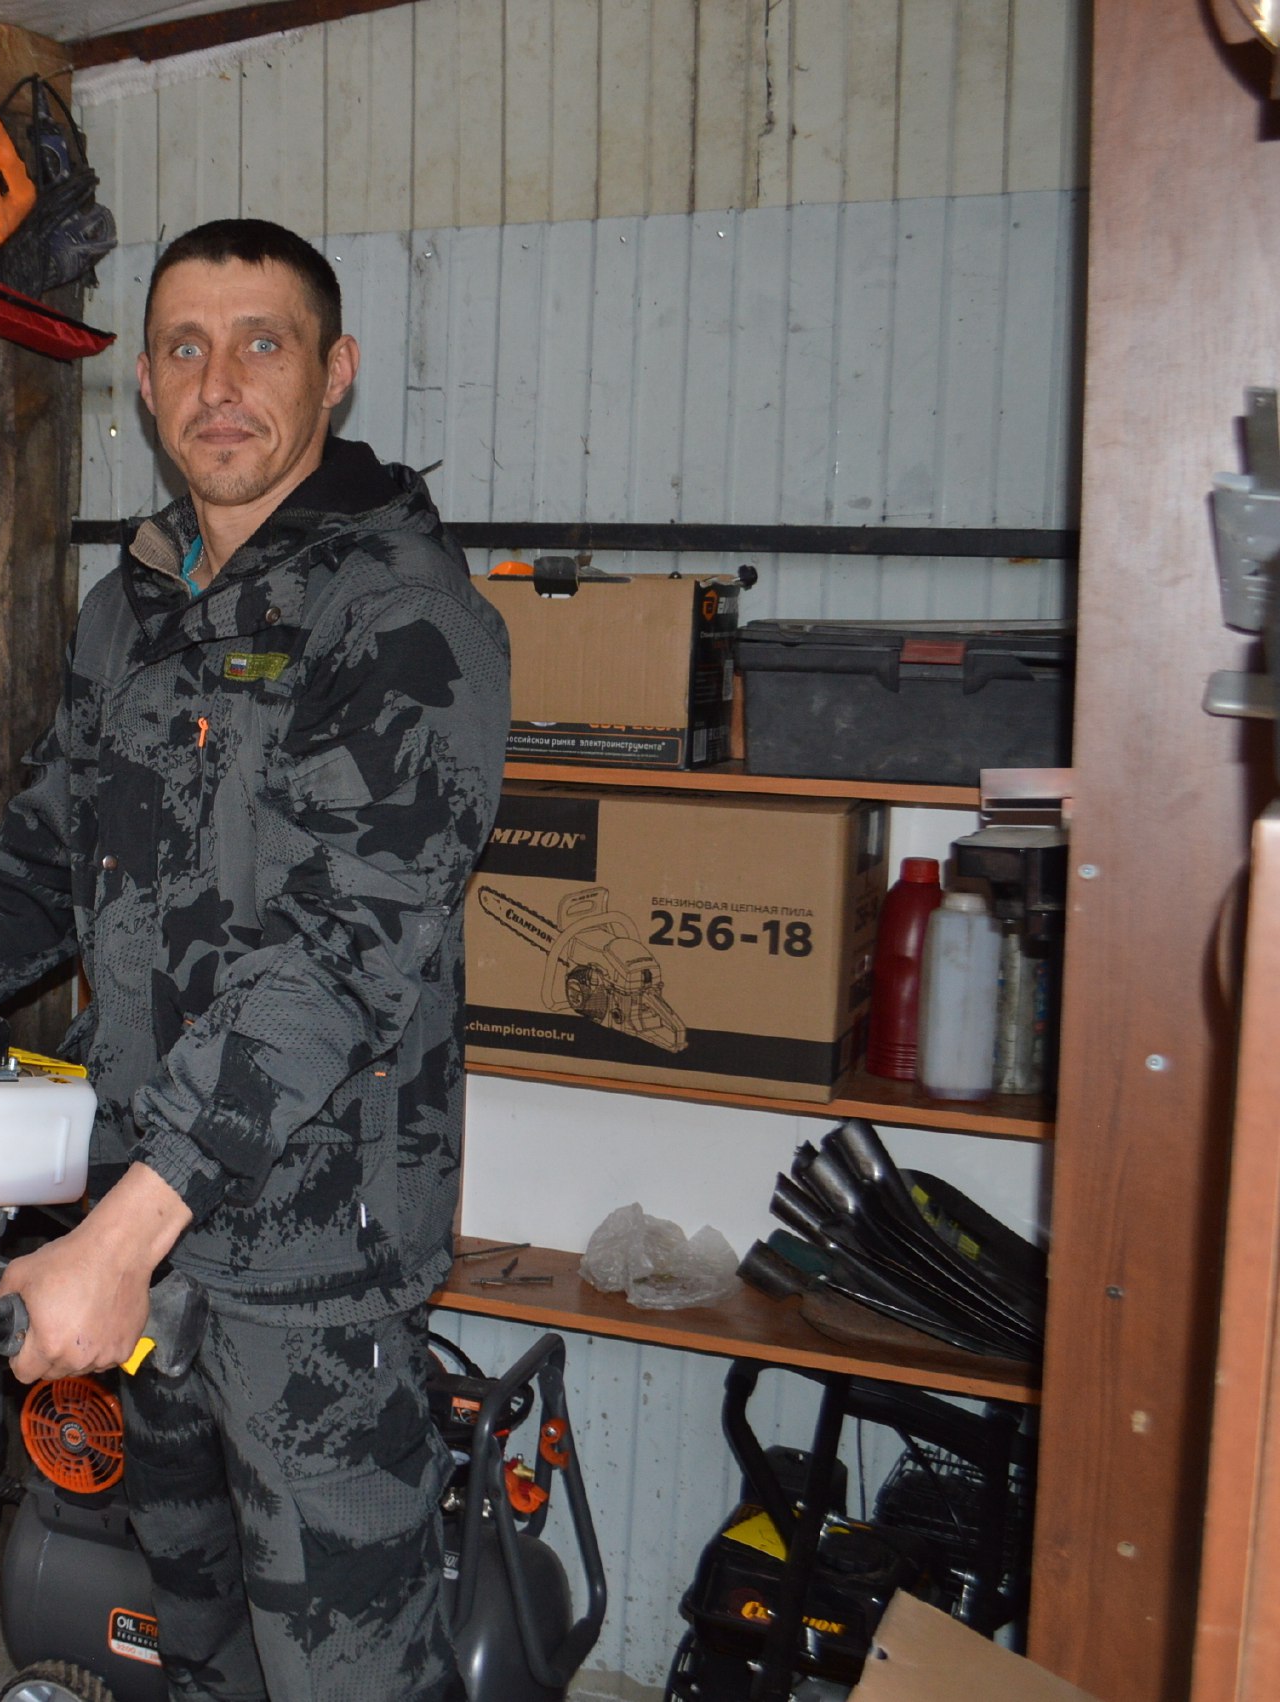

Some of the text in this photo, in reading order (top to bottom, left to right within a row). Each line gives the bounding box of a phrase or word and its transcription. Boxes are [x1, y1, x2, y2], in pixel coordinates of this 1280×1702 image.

[551, 738, 576, 748] рынке
[651, 896, 814, 918] БЕНЗИНОВАЯ ЦЕПНАЯ ПИЛА
[505, 907, 555, 944] CHAMPION
[648, 909, 813, 958] 256-18
[116, 1615, 136, 1632] OIL
